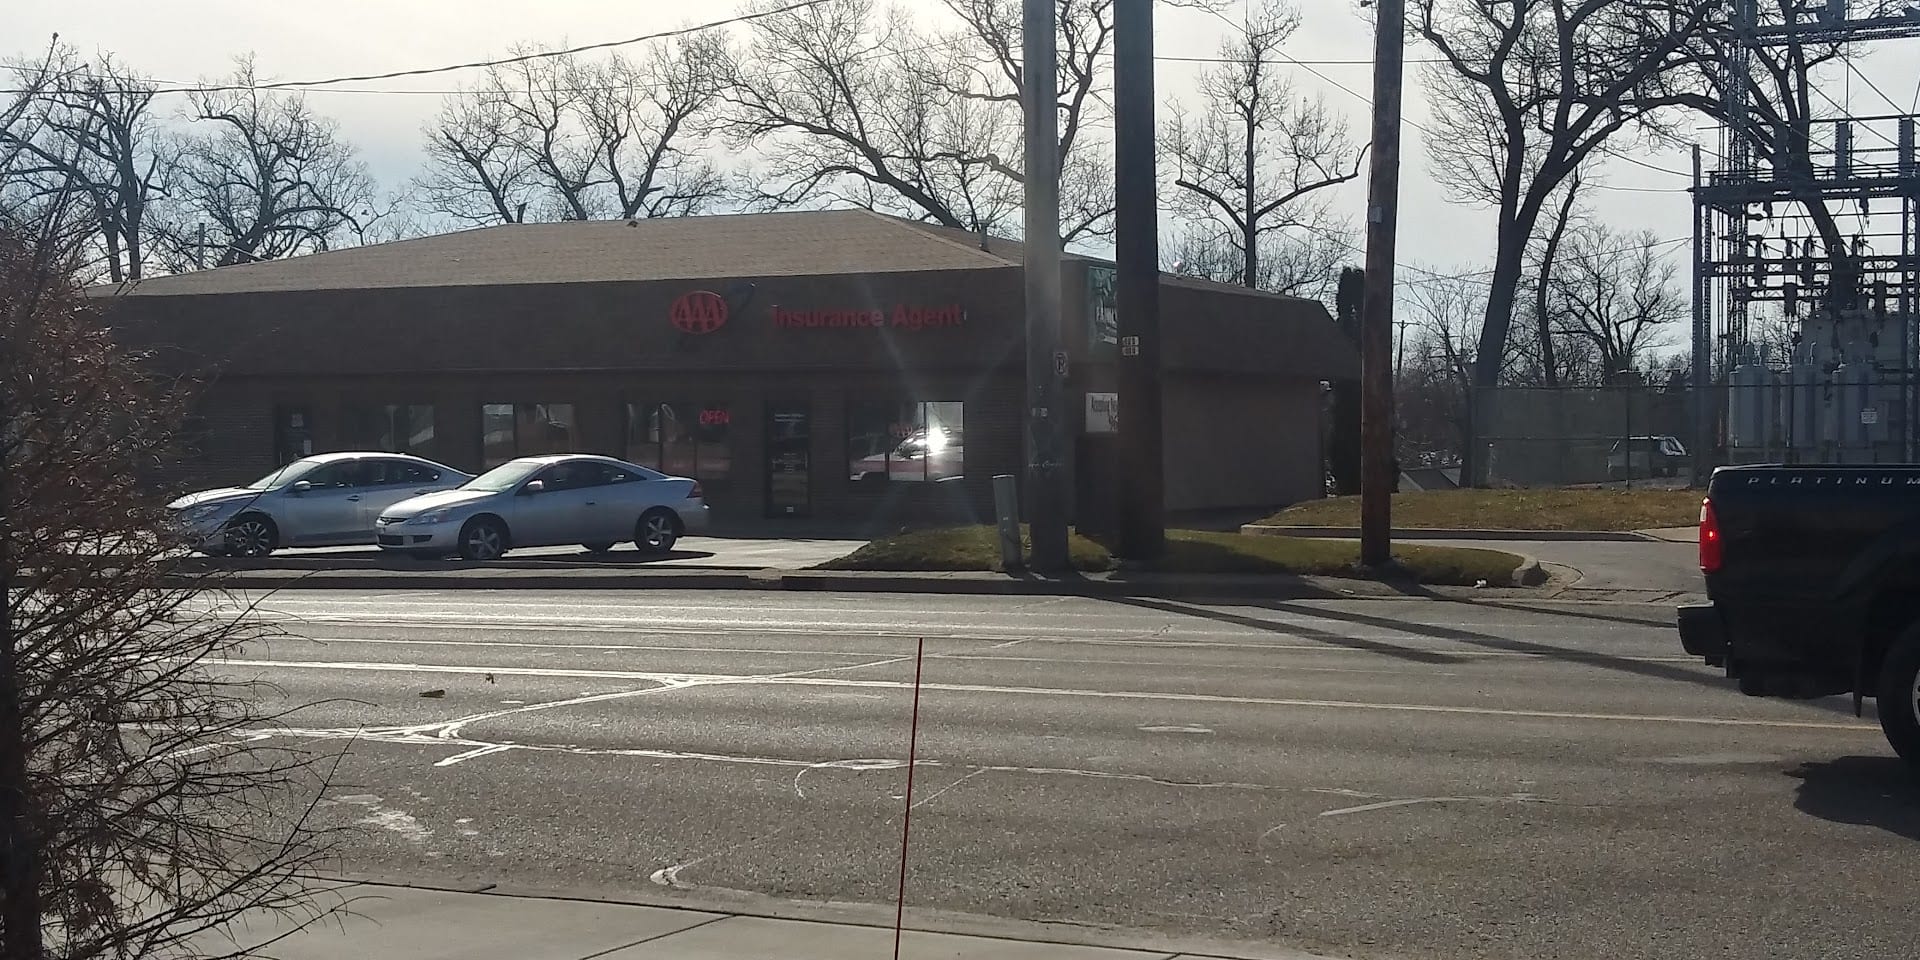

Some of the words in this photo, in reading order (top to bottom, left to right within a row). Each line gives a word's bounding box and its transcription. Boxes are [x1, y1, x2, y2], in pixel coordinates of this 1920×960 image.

[674, 295, 724, 330] AAA
[772, 305, 884, 328] Insurance
[891, 303, 962, 329] Agent
[699, 409, 730, 425] OPEN
[1747, 476, 1920, 486] PLATINUM
